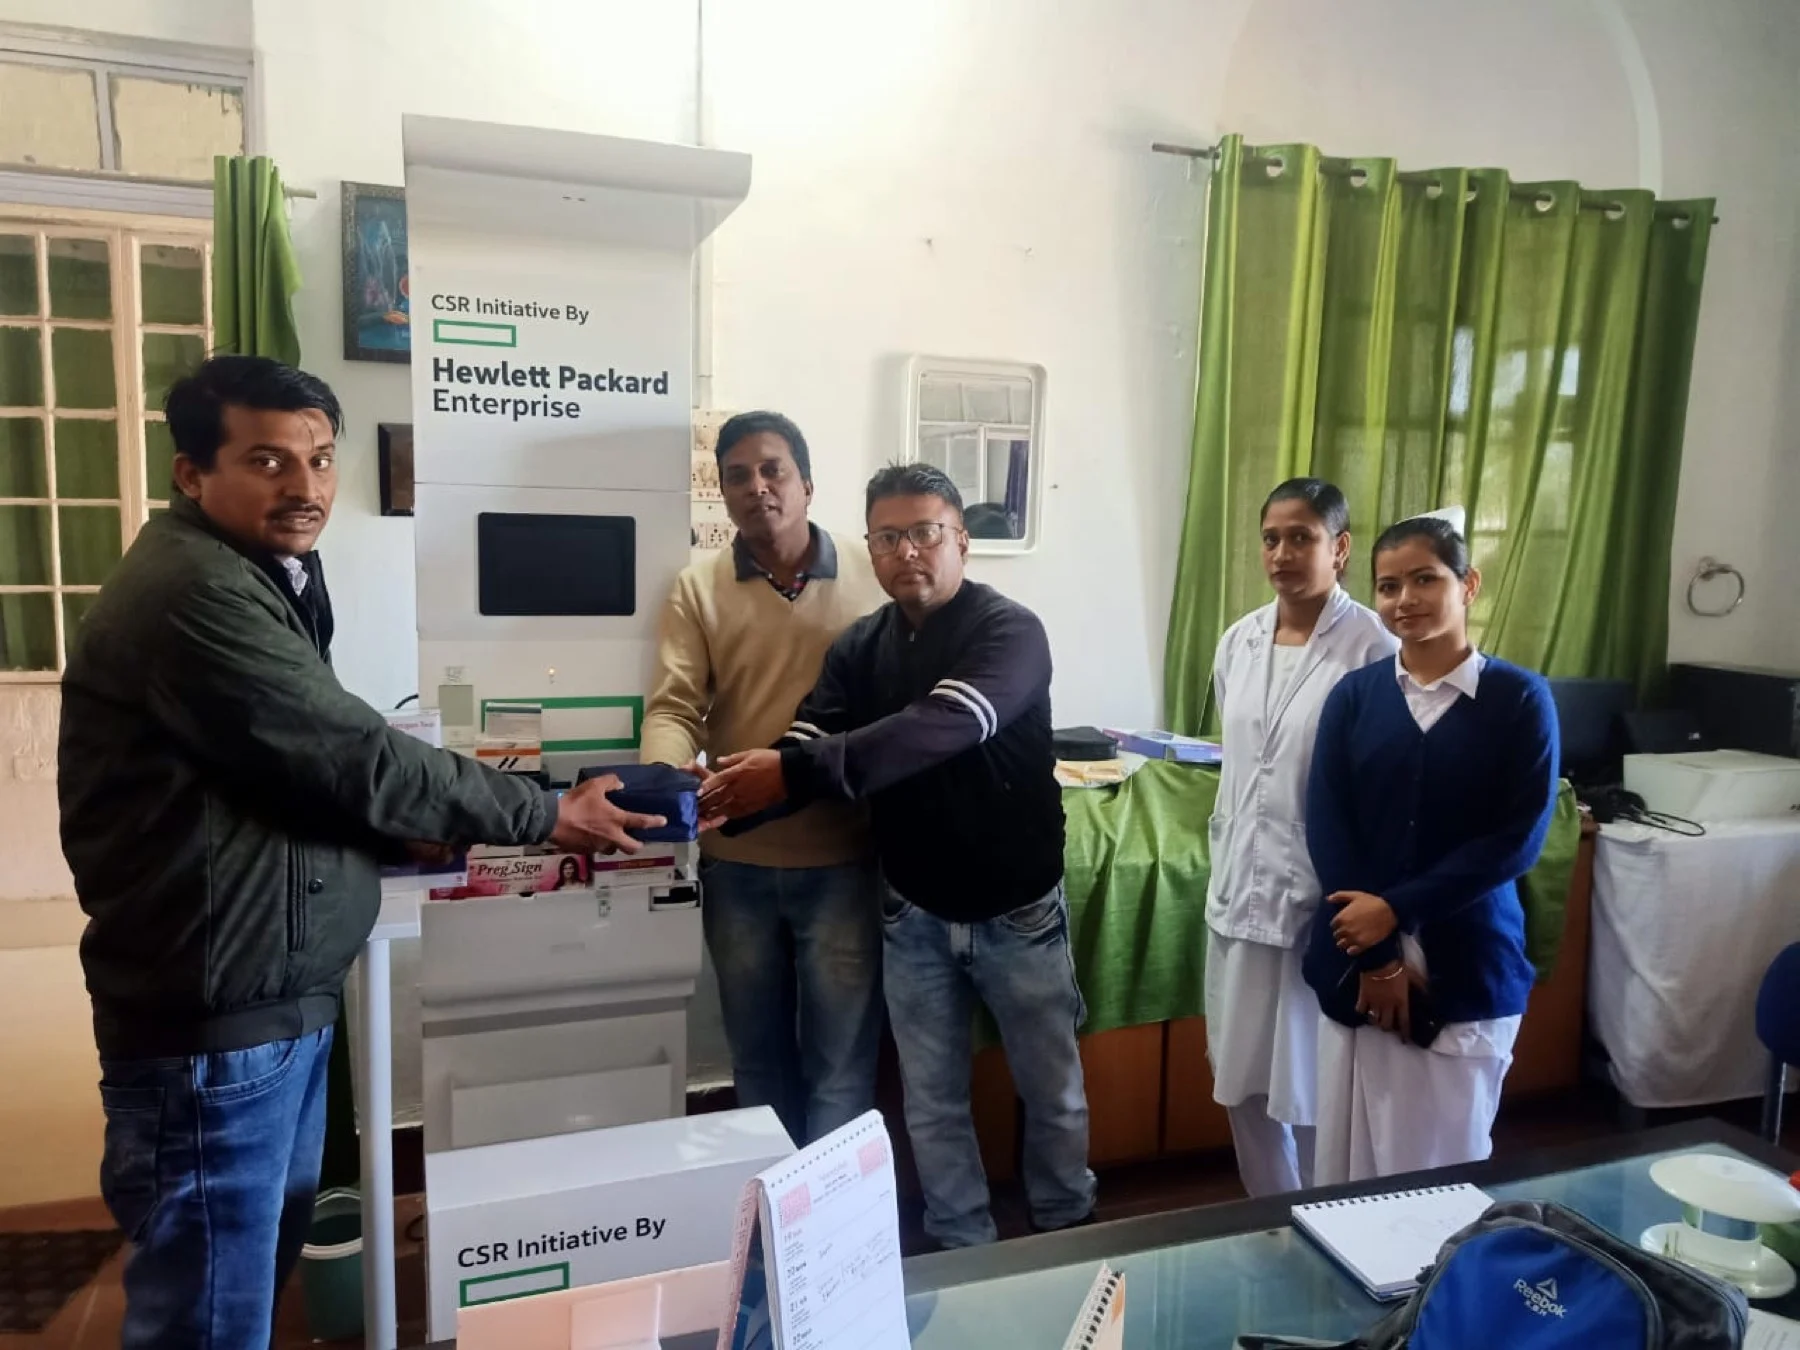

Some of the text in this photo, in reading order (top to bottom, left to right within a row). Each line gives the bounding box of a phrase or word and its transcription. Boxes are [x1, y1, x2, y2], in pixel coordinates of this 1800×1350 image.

[431, 294, 590, 326] CSR Initiative By
[432, 356, 669, 395] Hewlett Packard
[432, 387, 581, 423] Enterprise
[512, 860, 543, 876] Sign
[457, 1217, 666, 1268] CSR Initiative By
[1513, 1278, 1568, 1319] Reebok
